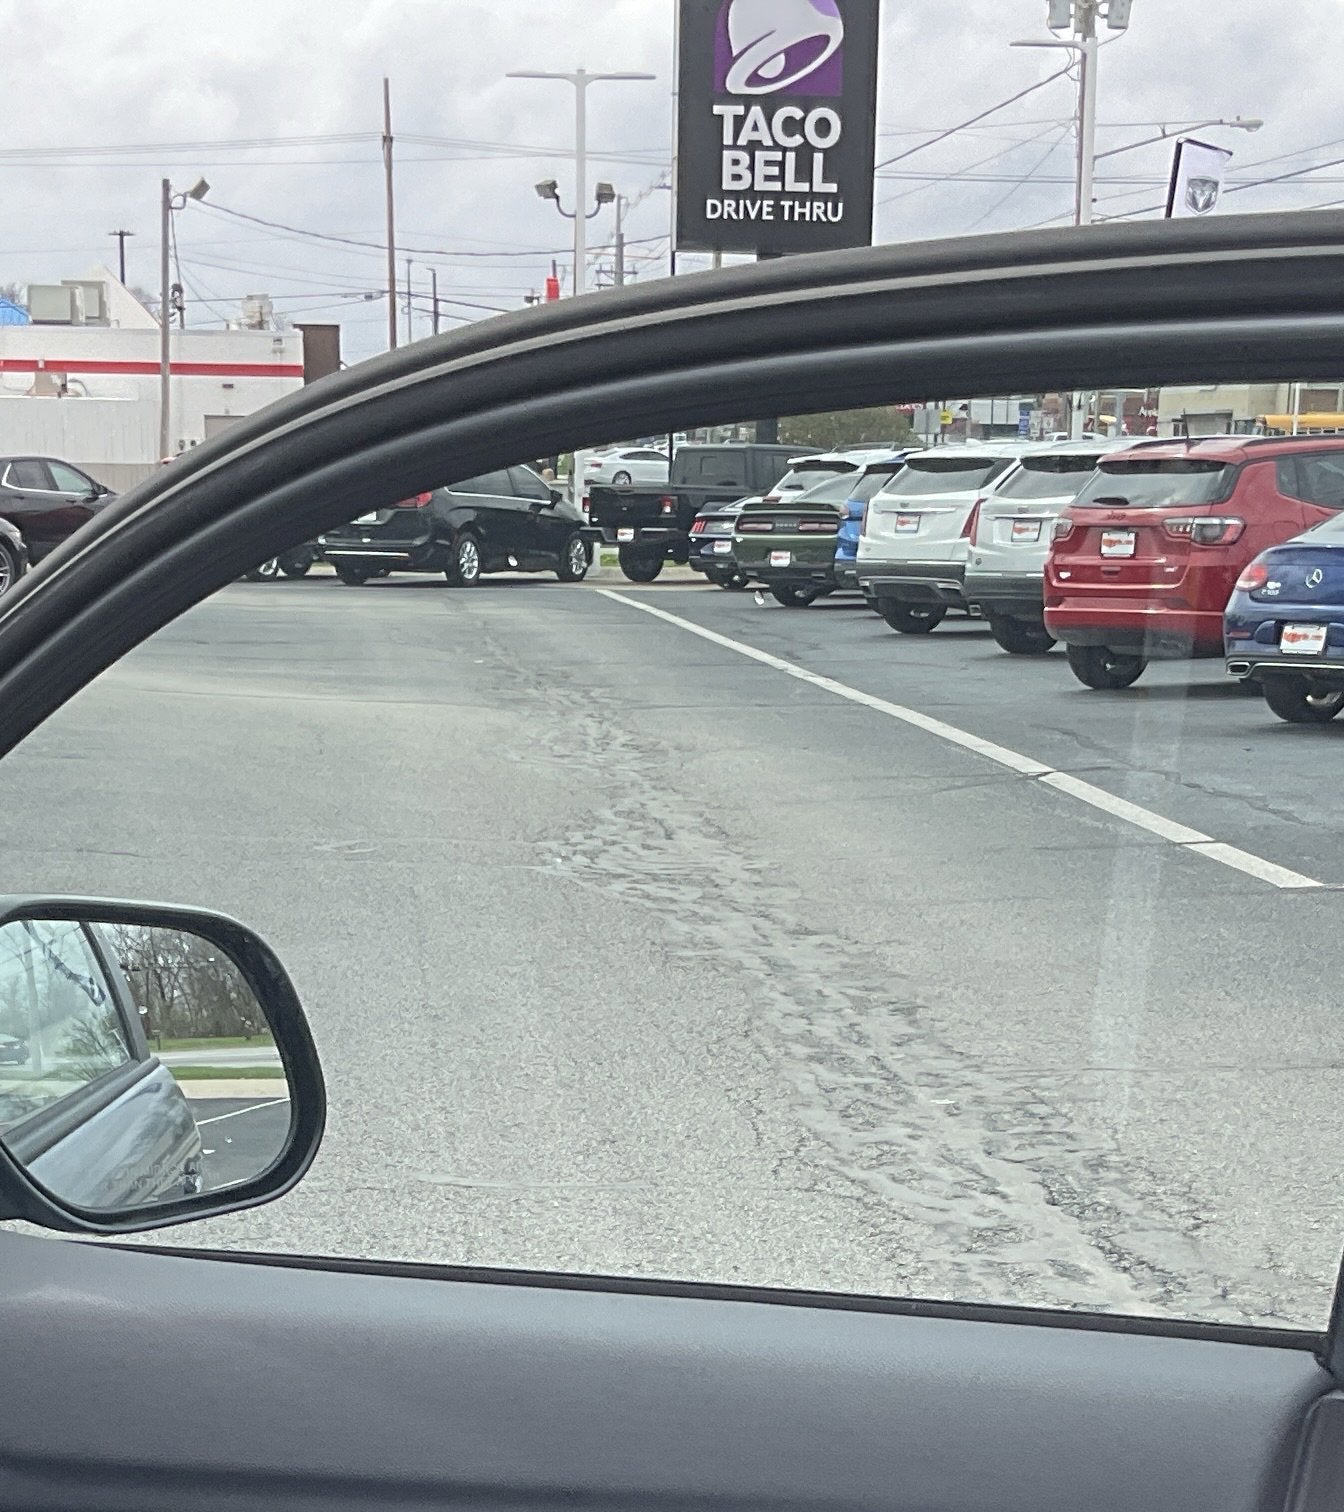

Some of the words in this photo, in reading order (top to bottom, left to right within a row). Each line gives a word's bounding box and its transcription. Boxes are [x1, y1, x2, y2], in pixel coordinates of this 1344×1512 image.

[712, 104, 842, 149] TACO
[721, 150, 838, 193] BELL
[706, 199, 774, 220] DRIVE
[780, 201, 844, 222] THRU
